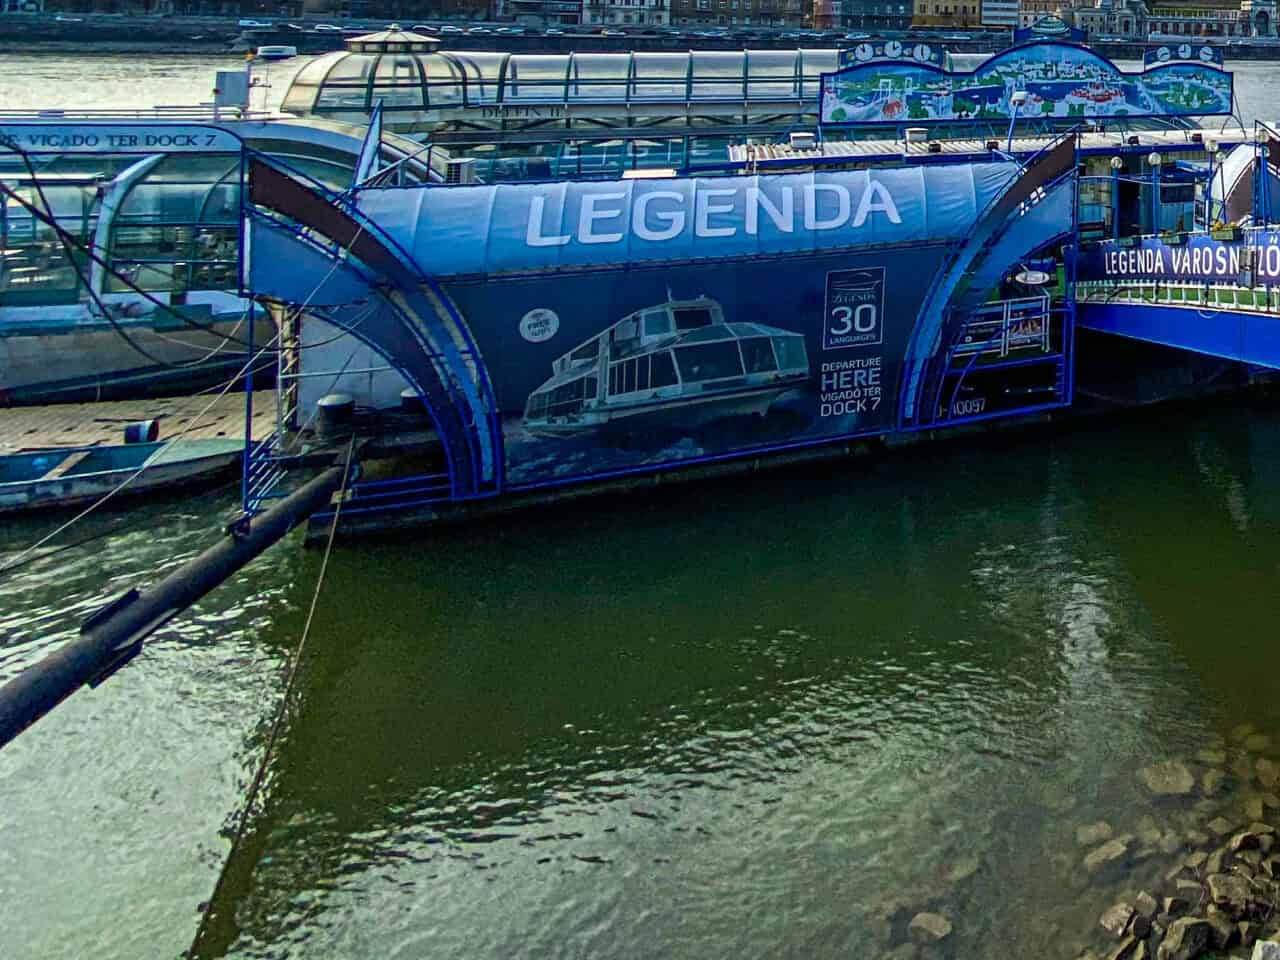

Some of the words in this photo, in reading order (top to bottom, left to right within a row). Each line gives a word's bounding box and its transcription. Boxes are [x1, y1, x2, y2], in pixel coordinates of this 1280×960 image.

[106, 135, 138, 147] TER
[145, 134, 198, 147] DOCK
[204, 134, 217, 147] 7
[526, 180, 902, 247] LEGENDA
[1105, 247, 1164, 275] LEGENDA
[830, 304, 877, 335] 30
[821, 356, 881, 372] DEPARTURE
[821, 367, 881, 391] HERE
[820, 399, 867, 417] DOCK
[870, 396, 881, 411] 7
